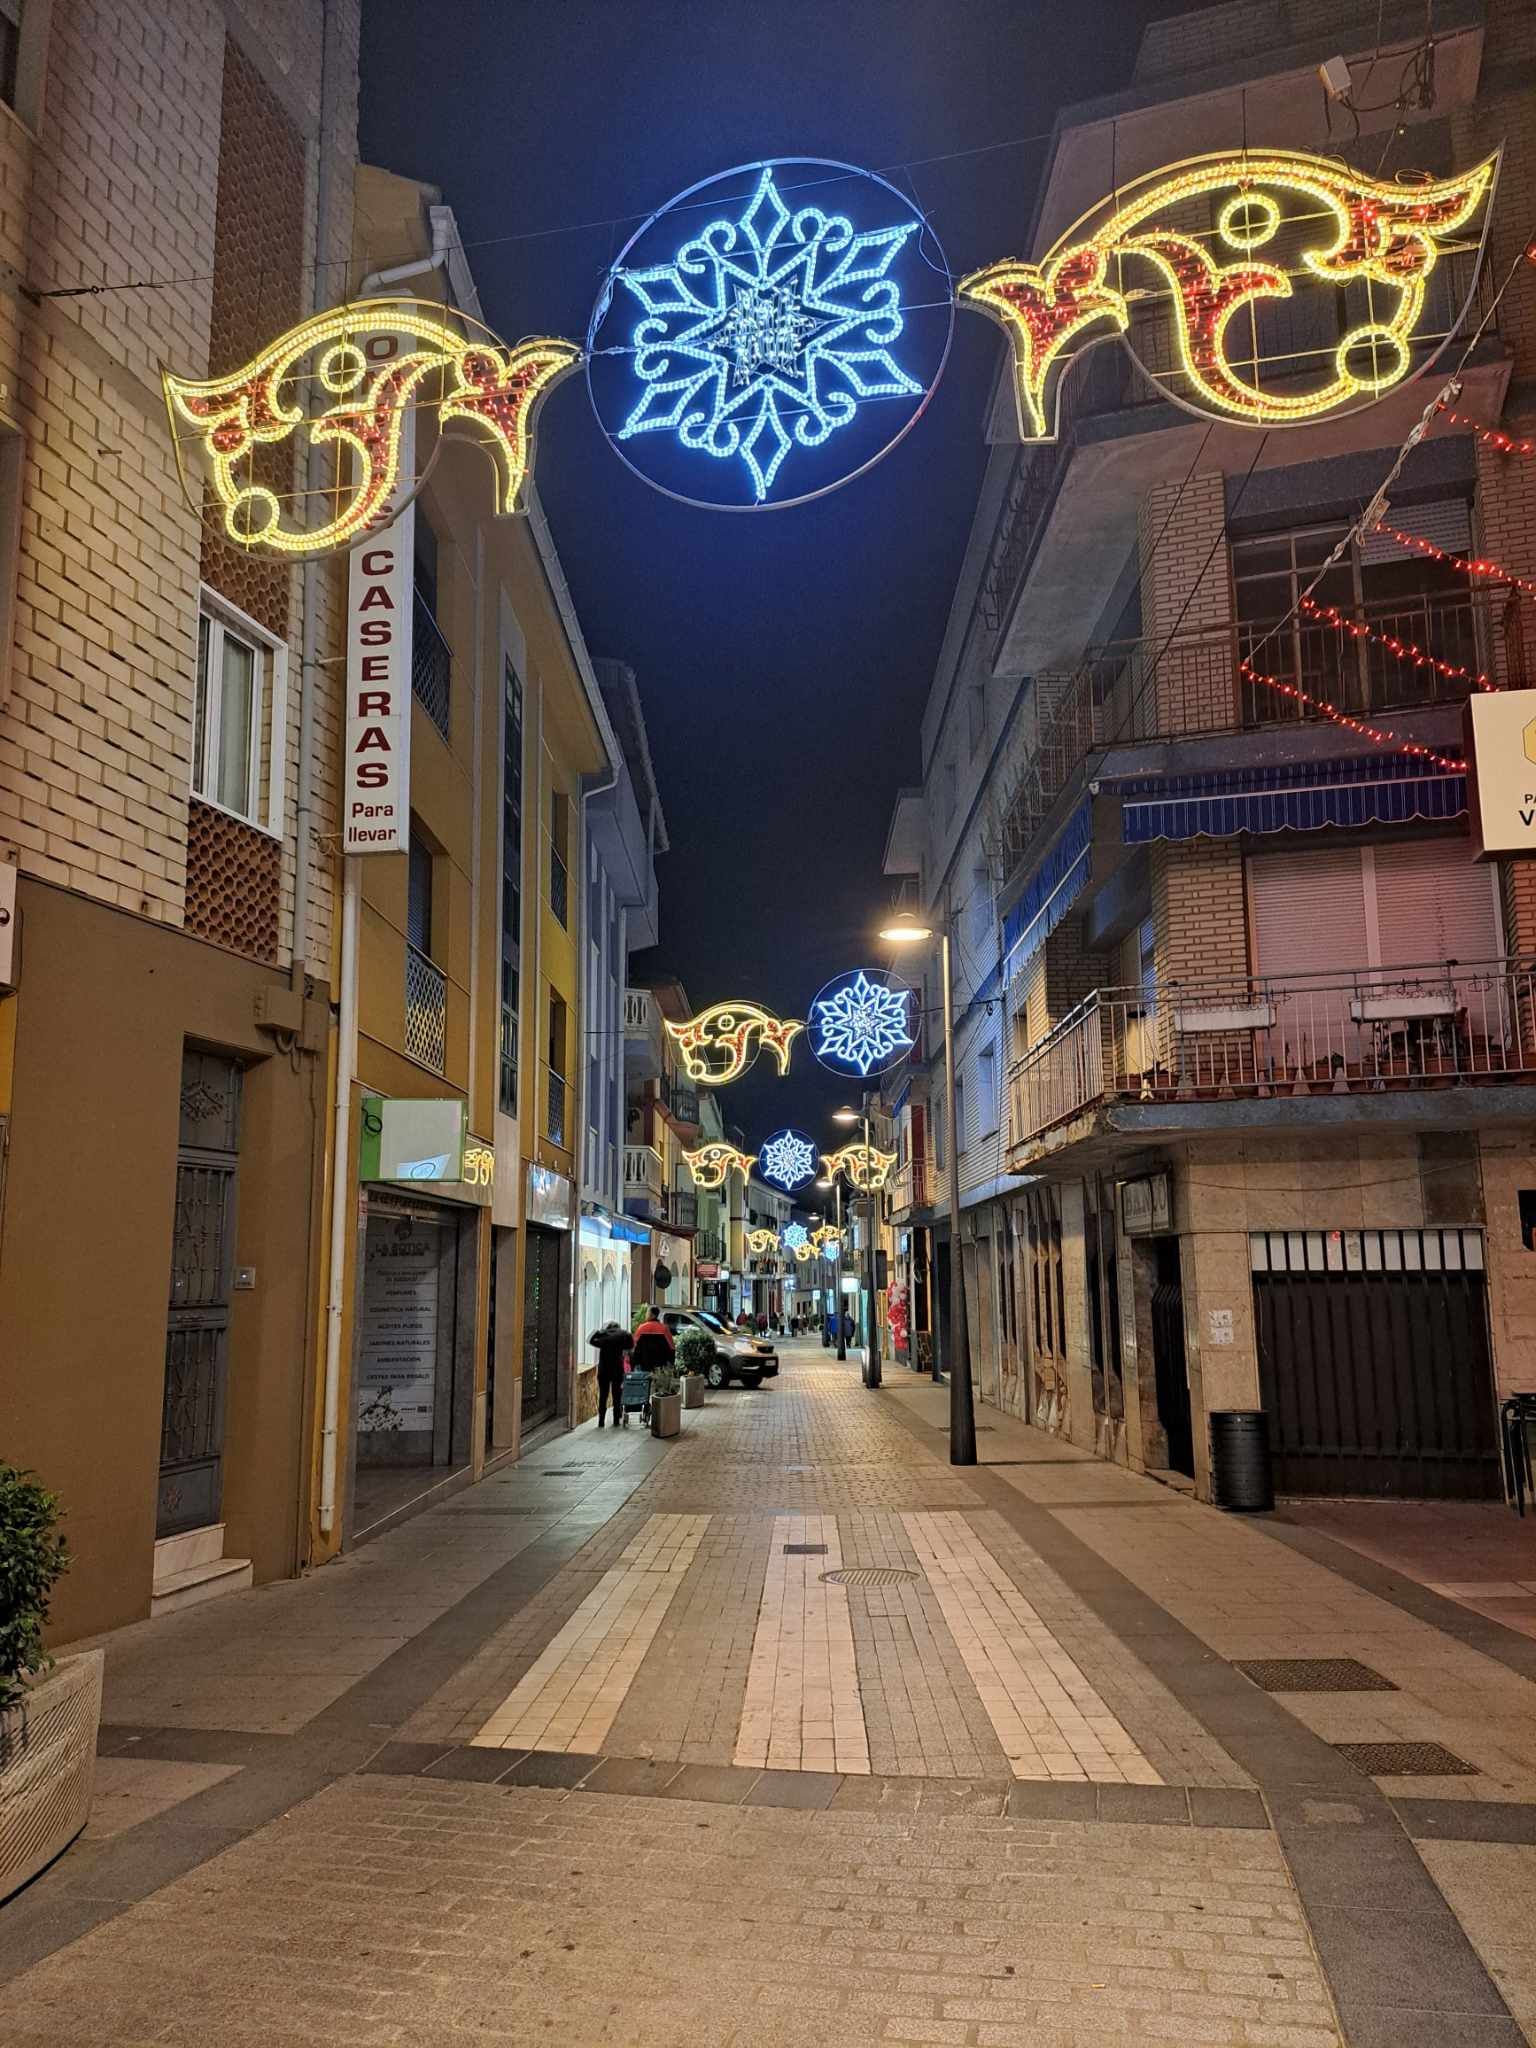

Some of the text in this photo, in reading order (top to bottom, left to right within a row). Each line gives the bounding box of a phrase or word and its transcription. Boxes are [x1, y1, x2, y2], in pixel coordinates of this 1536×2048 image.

[354, 550, 395, 789] CASERAS
[352, 803, 394, 818] Para
[348, 826, 397, 843] llevar
